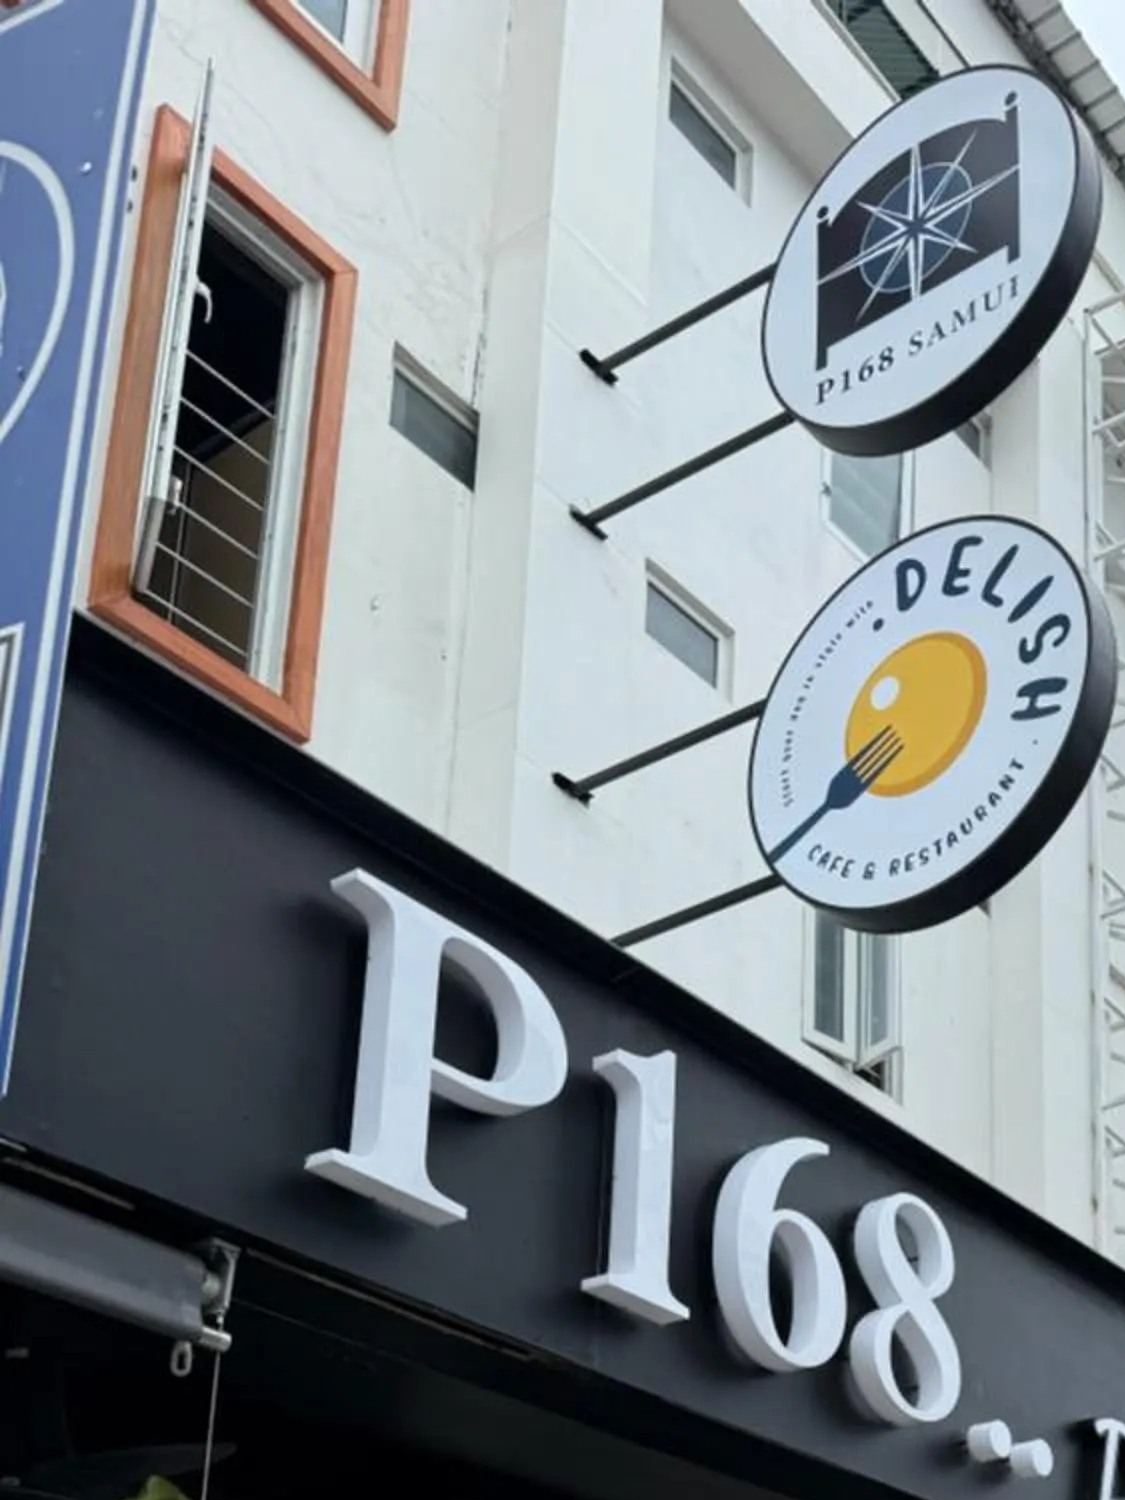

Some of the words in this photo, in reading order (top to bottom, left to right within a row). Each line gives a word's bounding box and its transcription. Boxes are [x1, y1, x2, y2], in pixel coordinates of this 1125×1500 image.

[816, 347, 894, 404] P168
[908, 275, 1021, 357] SAMUI
[895, 535, 1072, 721] DELISH
[807, 844, 855, 880] CAFE
[862, 862, 878, 881] &
[888, 759, 1026, 877] RESTAURANT
